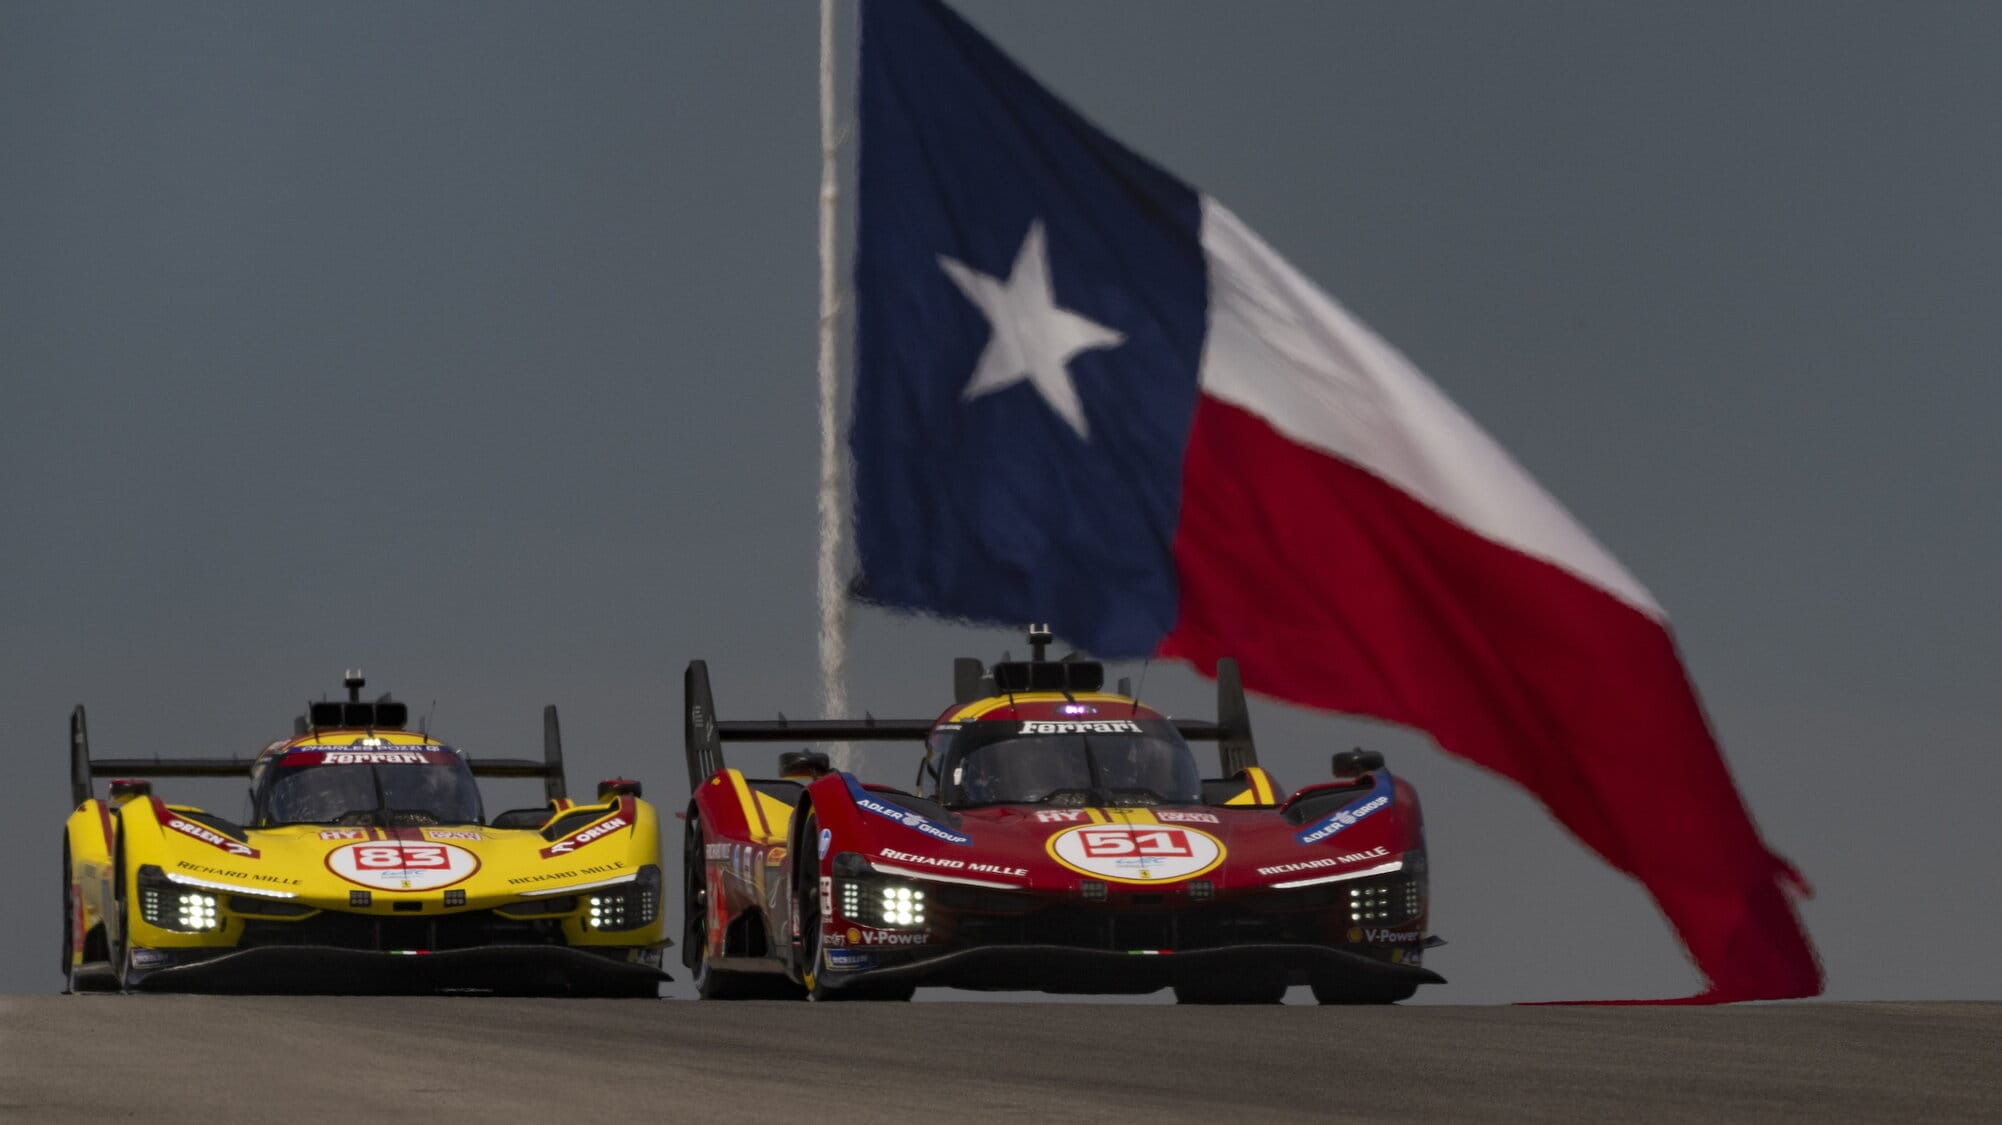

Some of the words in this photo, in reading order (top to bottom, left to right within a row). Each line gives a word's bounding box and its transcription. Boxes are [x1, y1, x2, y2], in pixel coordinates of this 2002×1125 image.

[1018, 720, 1143, 734] Ferrari
[321, 751, 430, 764] Ferrari
[168, 819, 225, 845] ORLEN
[575, 817, 627, 843] ORLEN
[856, 799, 902, 820] ADLER
[918, 823, 968, 843] GROUP
[1302, 822, 1344, 843] ADLER
[1352, 796, 1388, 817] GROUP
[1085, 832, 1187, 854] 51
[359, 848, 446, 867] 83
[879, 847, 965, 869] RICHARD
[967, 863, 1029, 877] MILLE
[1257, 858, 1337, 875] RICHARD
[1337, 846, 1390, 863] MILLE
[177, 860, 248, 879] RICHARD
[252, 874, 302, 885] MILLE
[508, 870, 578, 885] RICHARD
[580, 861, 624, 875] MILLE
[862, 931, 929, 945] V-Power
